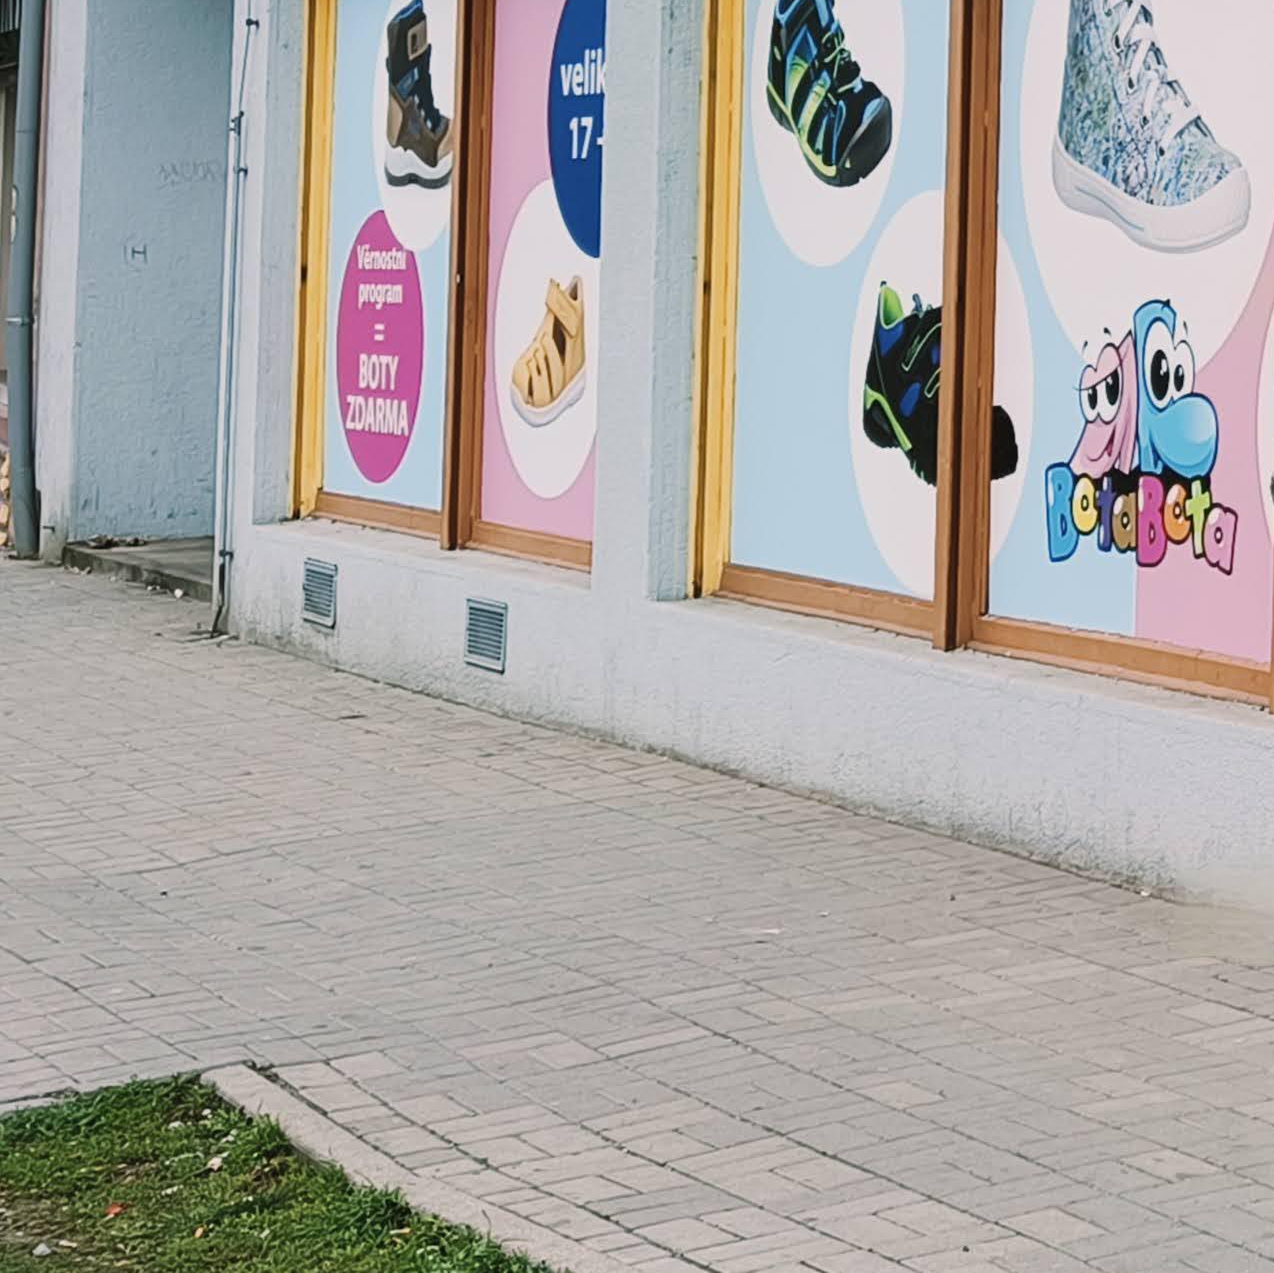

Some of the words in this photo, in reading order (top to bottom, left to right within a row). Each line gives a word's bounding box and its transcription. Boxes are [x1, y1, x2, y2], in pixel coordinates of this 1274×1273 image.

[569, 116, 594, 160] 17
[358, 284, 403, 310] program
[358, 354, 399, 391] BOTY
[346, 395, 409, 437] ZDARMA
